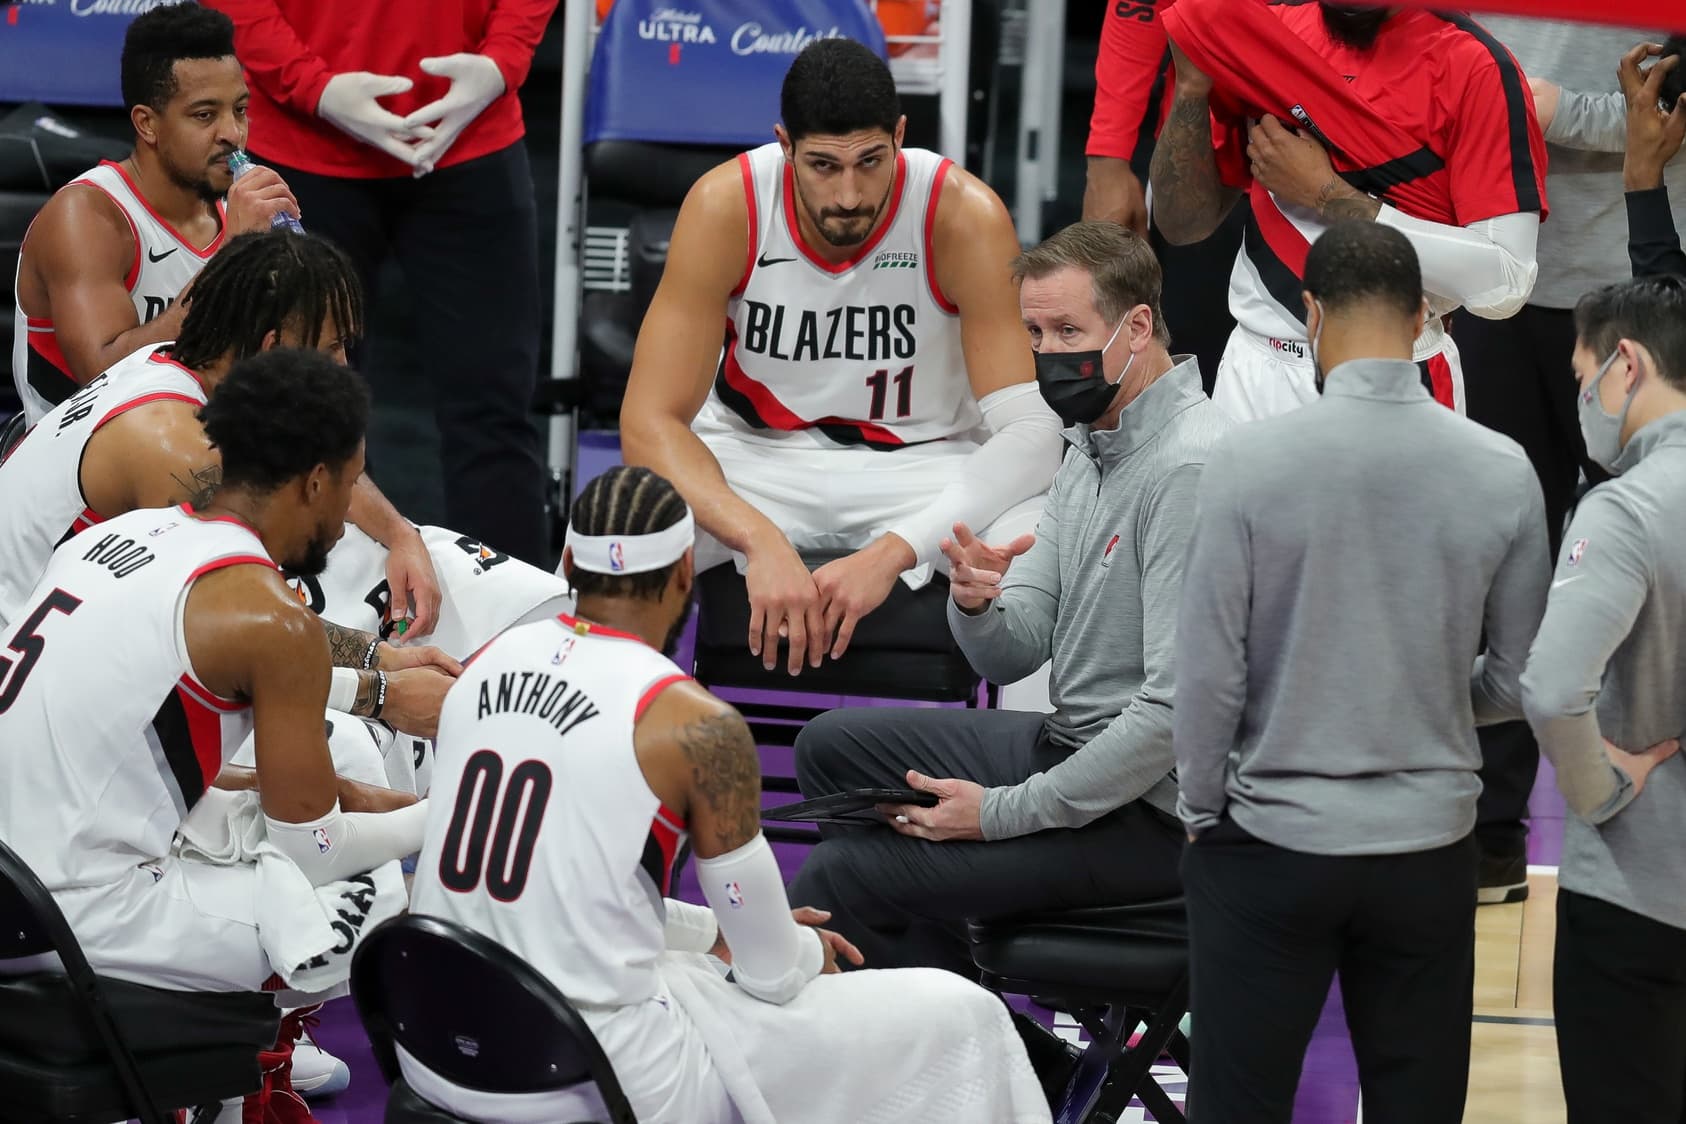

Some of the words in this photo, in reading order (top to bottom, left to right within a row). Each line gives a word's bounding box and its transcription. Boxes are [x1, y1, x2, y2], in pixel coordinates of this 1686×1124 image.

[638, 20, 716, 44] ULTRA
[744, 299, 916, 361] BLAZERS
[866, 365, 915, 420] 11
[82, 533, 156, 579] HOOD
[478, 671, 601, 736] ANTHONY
[438, 749, 553, 903] 00
